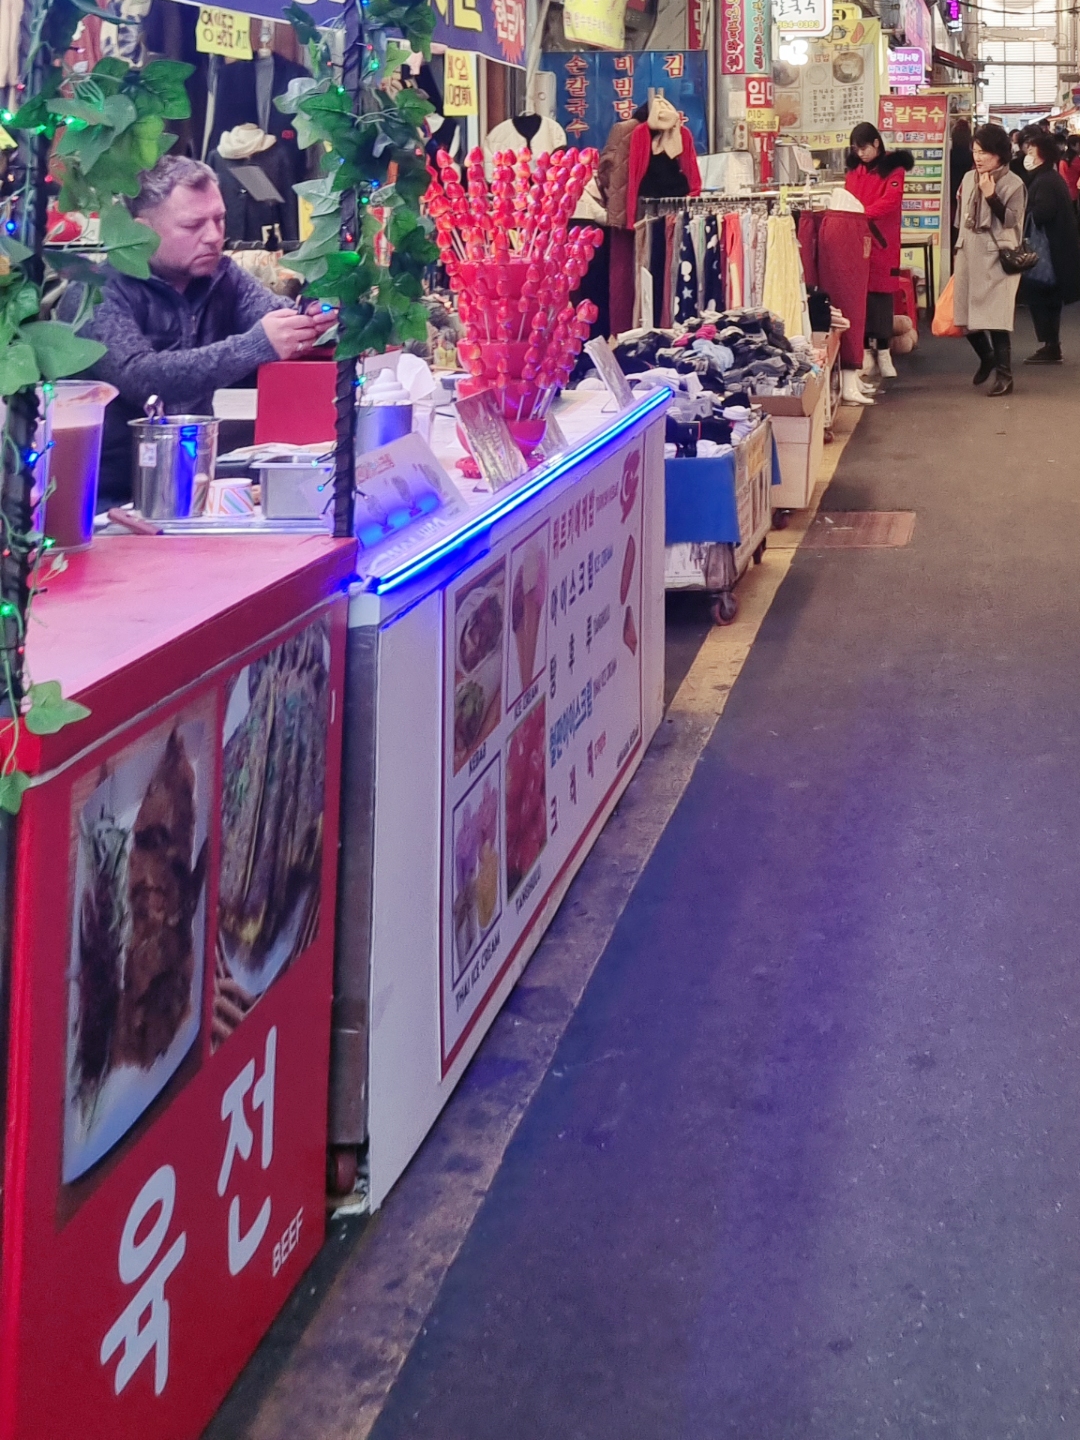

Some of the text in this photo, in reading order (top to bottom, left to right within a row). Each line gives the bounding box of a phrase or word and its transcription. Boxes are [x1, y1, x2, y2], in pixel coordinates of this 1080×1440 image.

[565, 54, 590, 139] 손칼국수
[613, 54, 638, 121] 비빔당
[895, 105, 945, 125] 칼국수
[271, 1207, 305, 1279] BEEF
